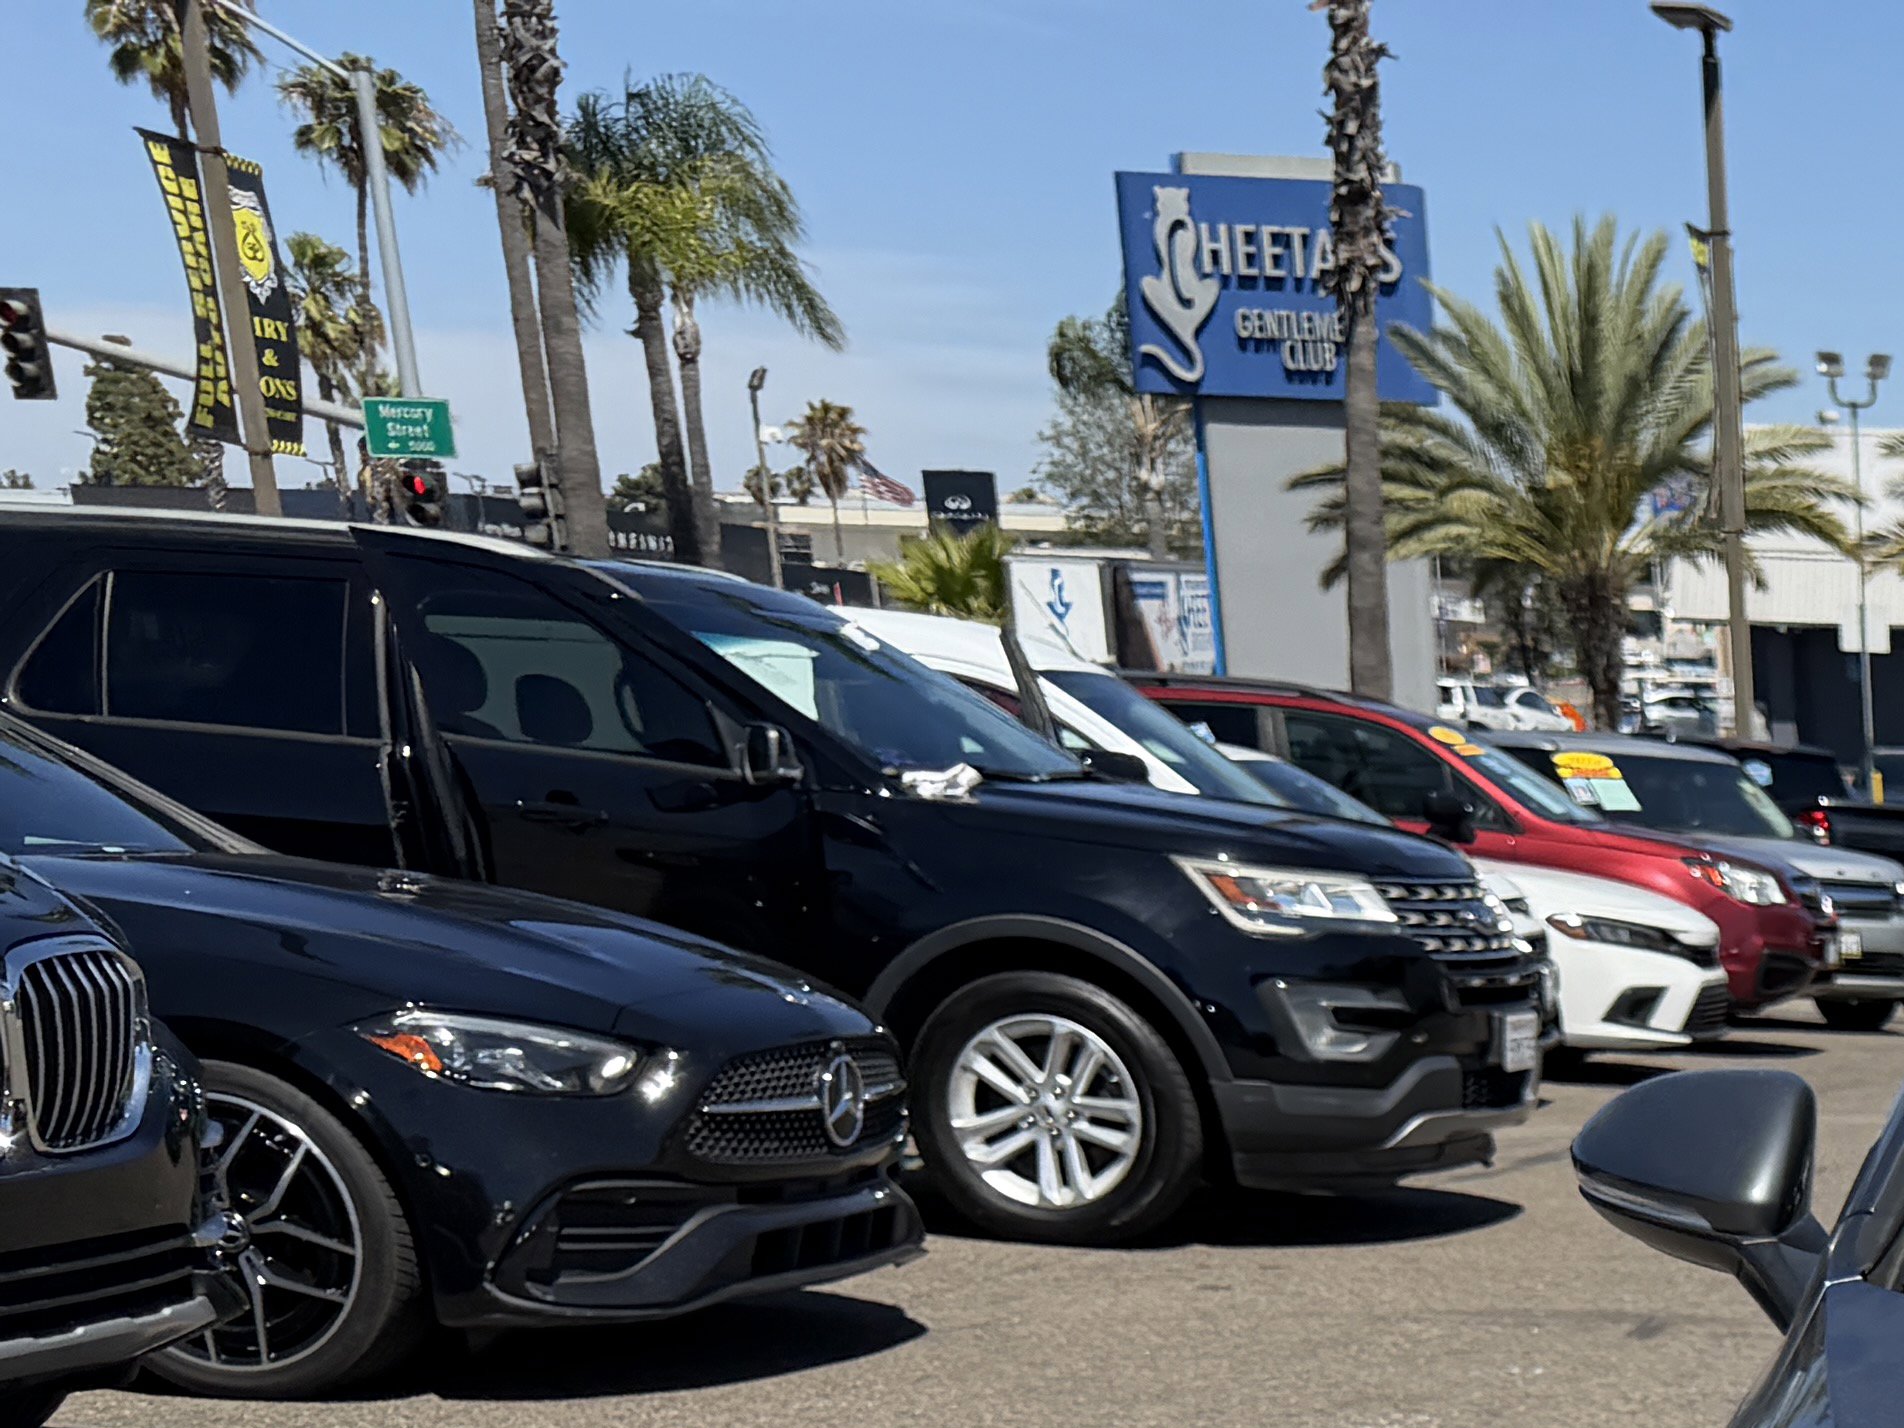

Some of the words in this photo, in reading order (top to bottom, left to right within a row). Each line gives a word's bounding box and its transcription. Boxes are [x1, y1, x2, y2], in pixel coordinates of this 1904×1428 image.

[1200, 221, 1403, 284] HEETAS
[252, 316, 289, 342] IRY
[1234, 308, 1346, 343] GENTLEME
[261, 348, 280, 367] &
[1281, 340, 1338, 372] CLUB
[259, 375, 298, 401] ONS
[386, 422, 430, 438] Street
